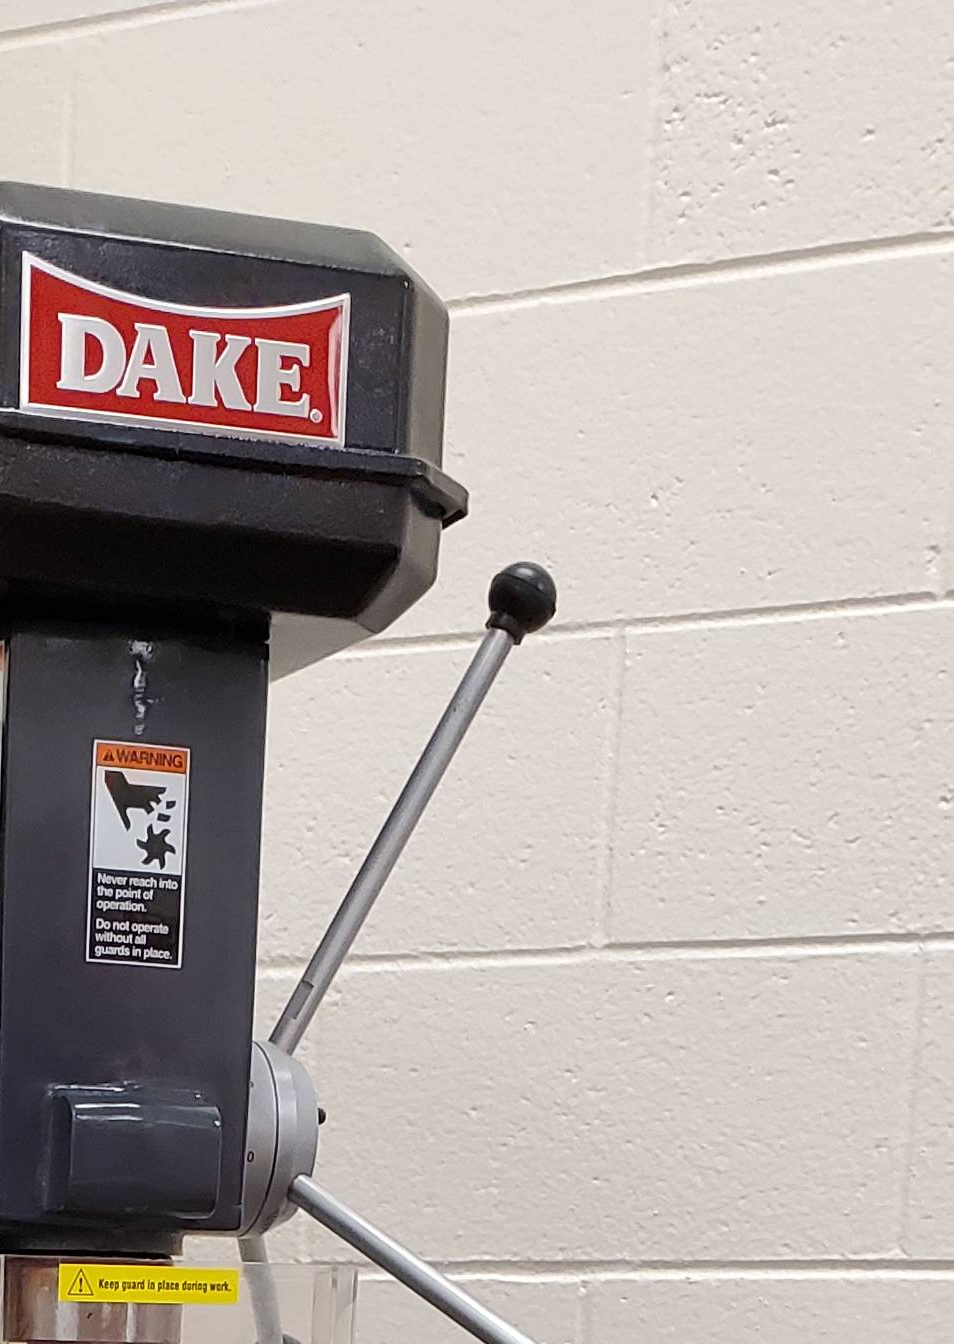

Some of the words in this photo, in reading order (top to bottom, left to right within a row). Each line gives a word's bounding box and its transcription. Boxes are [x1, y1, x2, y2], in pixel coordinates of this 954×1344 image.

[56, 312, 310, 418] DAKE
[116, 748, 183, 768] WARNING
[97, 872, 127, 886] Never
[129, 876, 157, 888] reach
[158, 877, 179, 890] into
[96, 885, 114, 897] the
[115, 887, 142, 900] point
[142, 889, 154, 900] of
[96, 900, 147, 912] operation.
[95, 918, 111, 930] Do
[112, 920, 130, 932] not
[131, 923, 169, 935] operate
[95, 931, 133, 944] without
[134, 934, 147, 945] all
[94, 945, 131, 957] guards
[131, 946, 142, 958] in
[143, 947, 173, 960] place.
[98, 1279, 120, 1291] Keep
[121, 1280, 146, 1292] guard
[147, 1280, 156, 1290] in
[157, 1280, 180, 1292] place
[182, 1281, 208, 1294] during
[209, 1282, 232, 1292] work.
